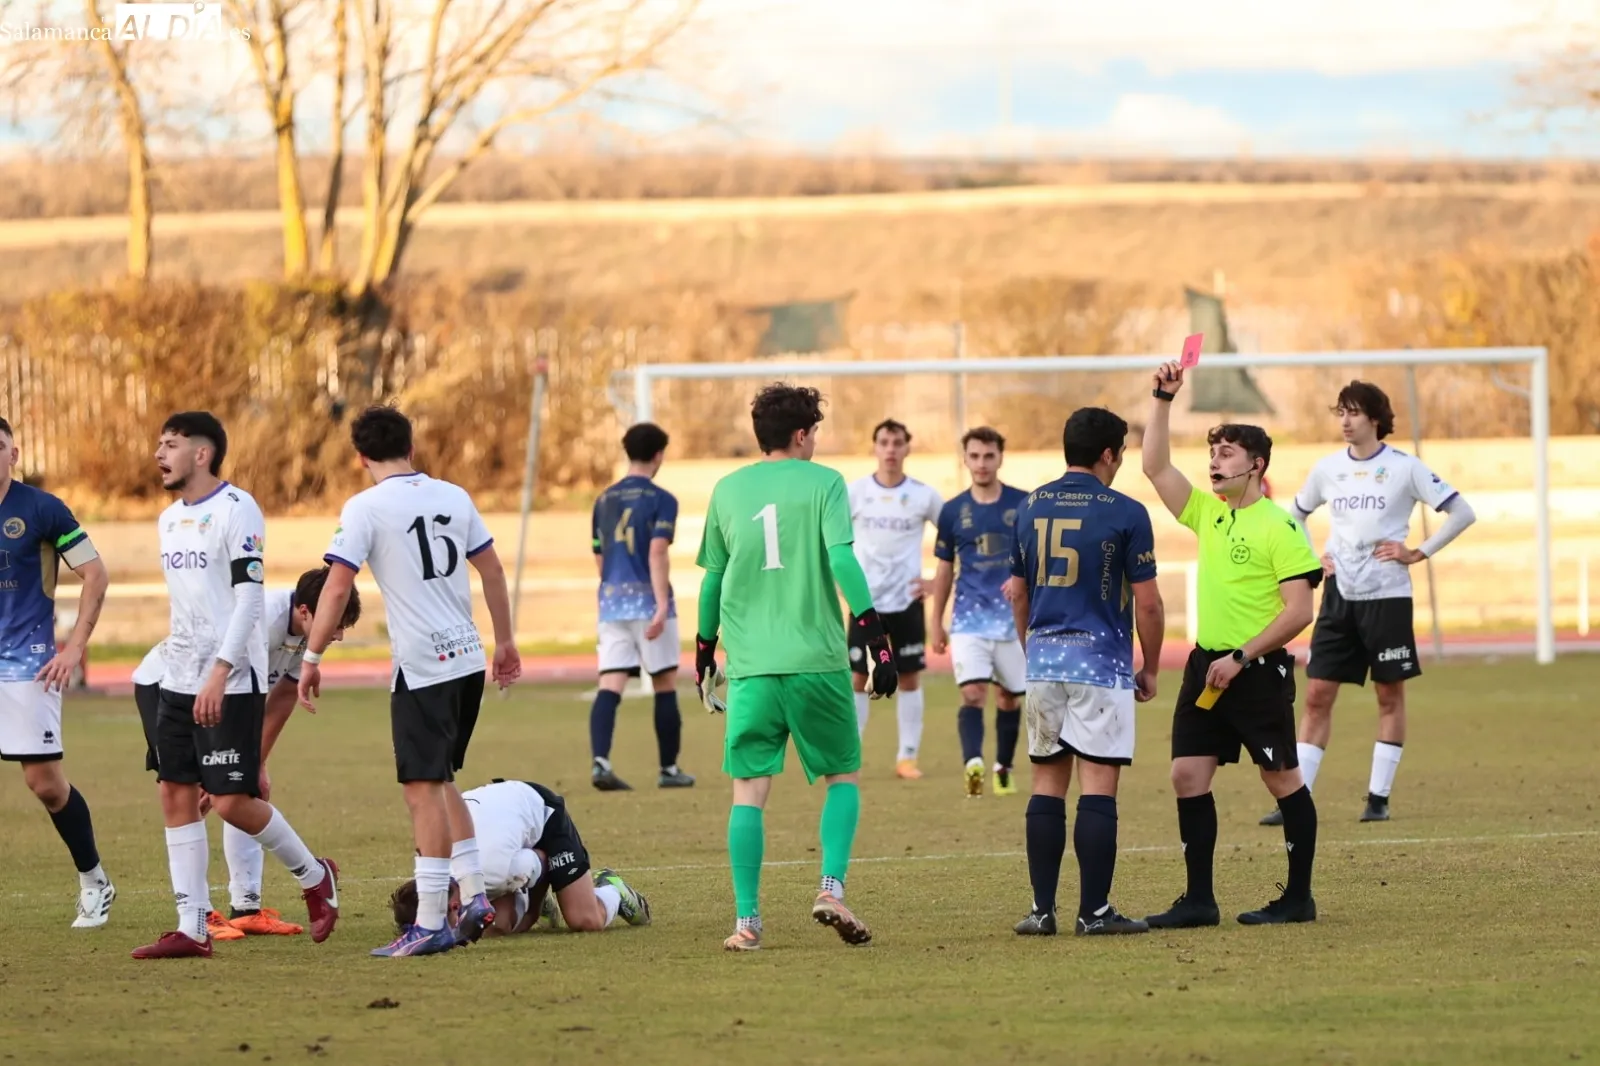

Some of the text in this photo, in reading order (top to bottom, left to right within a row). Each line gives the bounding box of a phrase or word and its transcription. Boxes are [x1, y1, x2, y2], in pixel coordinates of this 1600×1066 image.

[1039, 491, 1115, 504] De Castro Gil
[1333, 494, 1386, 511] meins
[406, 514, 458, 581] 15
[614, 507, 635, 555] 4
[751, 503, 785, 571] 1
[1033, 518, 1082, 587] 15
